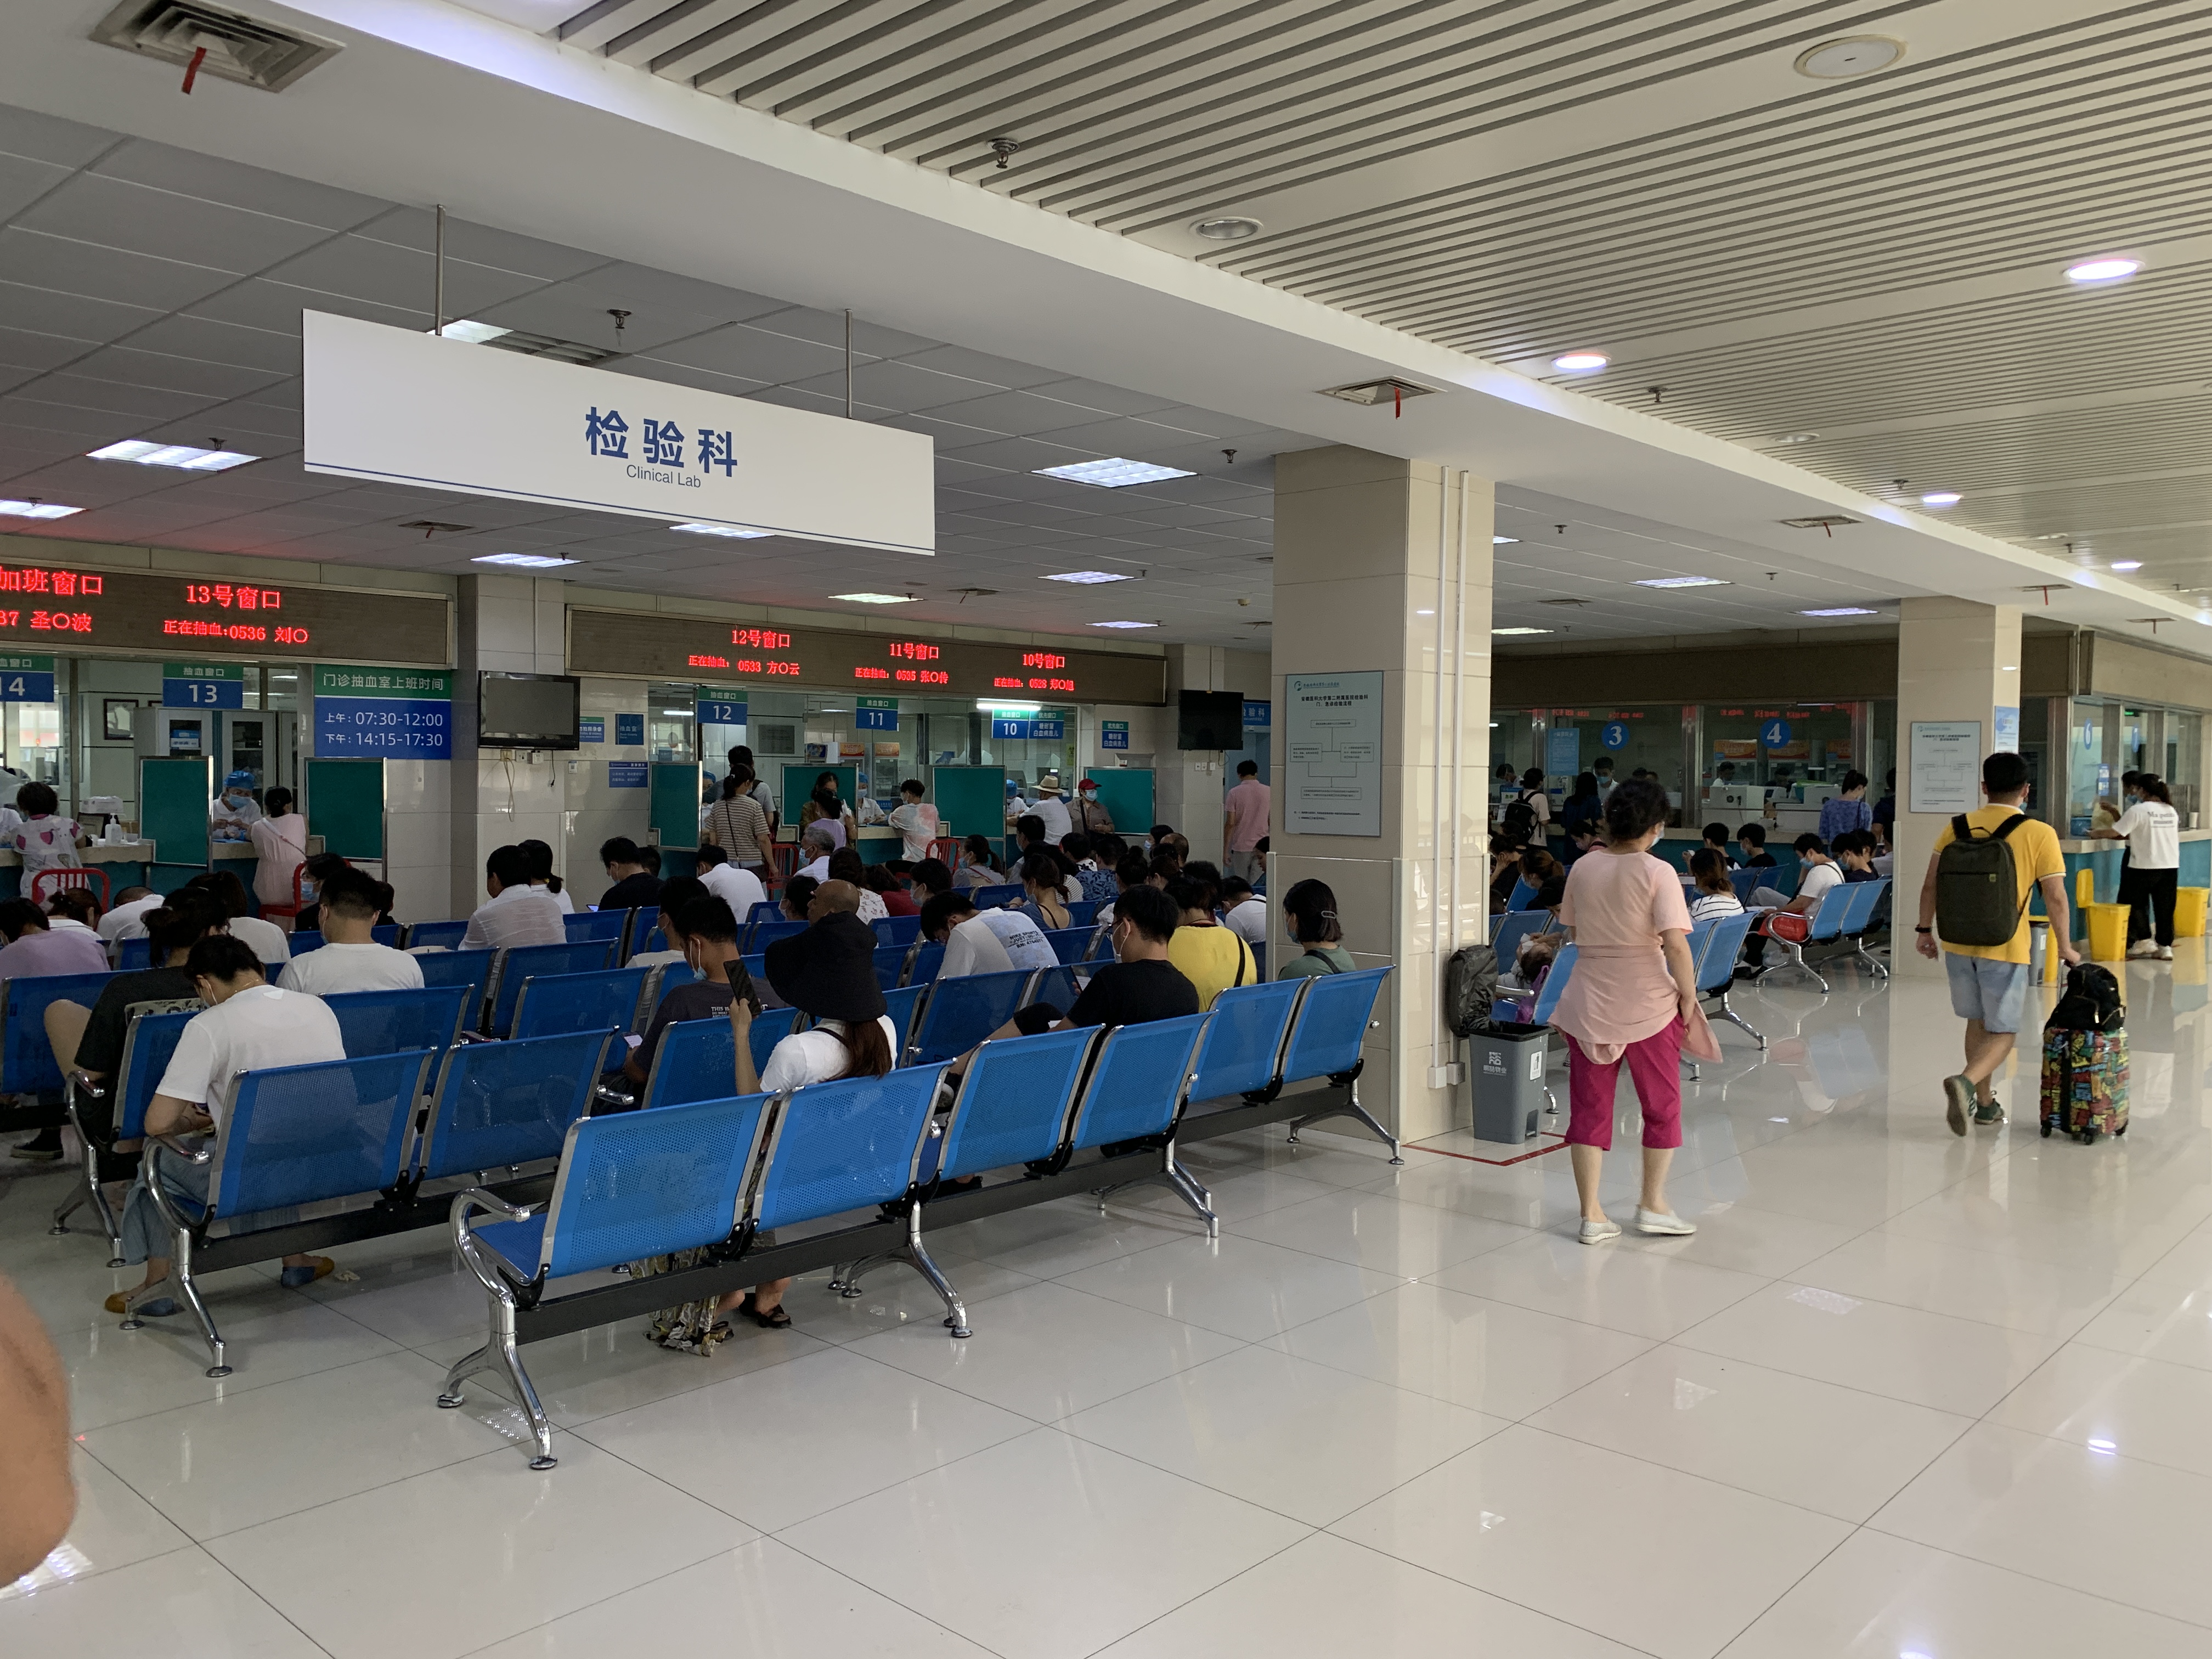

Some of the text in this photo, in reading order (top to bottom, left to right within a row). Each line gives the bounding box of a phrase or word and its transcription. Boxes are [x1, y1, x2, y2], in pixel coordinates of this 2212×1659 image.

[585, 406, 738, 477] 检验科
[627, 465, 701, 488] Clinical Lab
[0, 566, 103, 596] 加班窗口
[187, 584, 281, 610] 13号窗口
[732, 629, 791, 649] 12号窗口
[890, 642, 939, 660] 11号窗口
[737, 661, 761, 673] 0533
[1023, 653, 1065, 669] 10号窗口
[183, 667, 224, 676] 抽血窗口
[0, 677, 25, 696] 4
[323, 673, 443, 690] 门诊抽血室上班时间
[189, 685, 217, 703] 13
[713, 706, 731, 720] 12
[869, 712, 883, 726] 11
[1003, 723, 1017, 735] 10
[1609, 726, 1622, 746] 3
[1767, 723, 1782, 743] 4
[2086, 723, 2091, 745] 6
